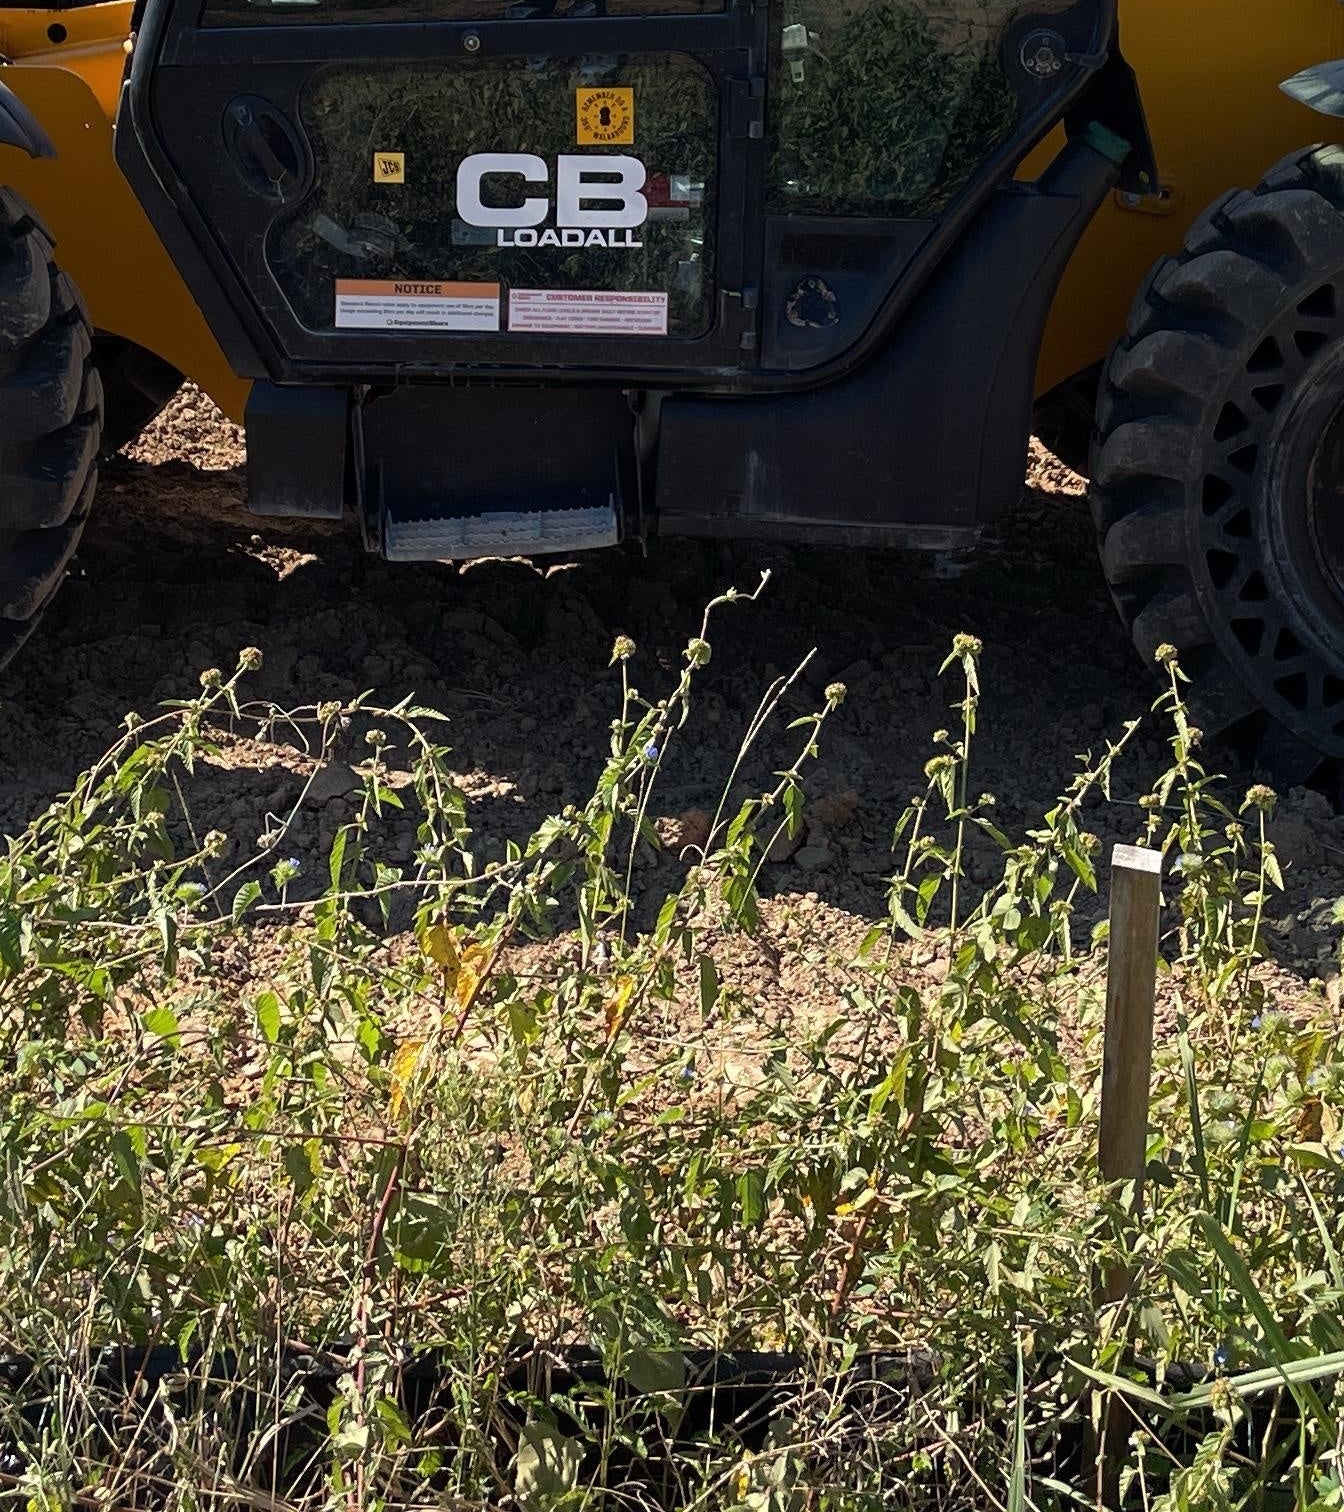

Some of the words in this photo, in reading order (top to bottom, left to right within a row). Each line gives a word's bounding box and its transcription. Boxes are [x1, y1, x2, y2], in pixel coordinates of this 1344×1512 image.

[457, 152, 648, 228] CB
[497, 228, 643, 248] LOADALL
[394, 283, 442, 295] NOTICE
[546, 293, 593, 302] CUSTOMER
[594, 295, 666, 304] RESPONSIBILITY
